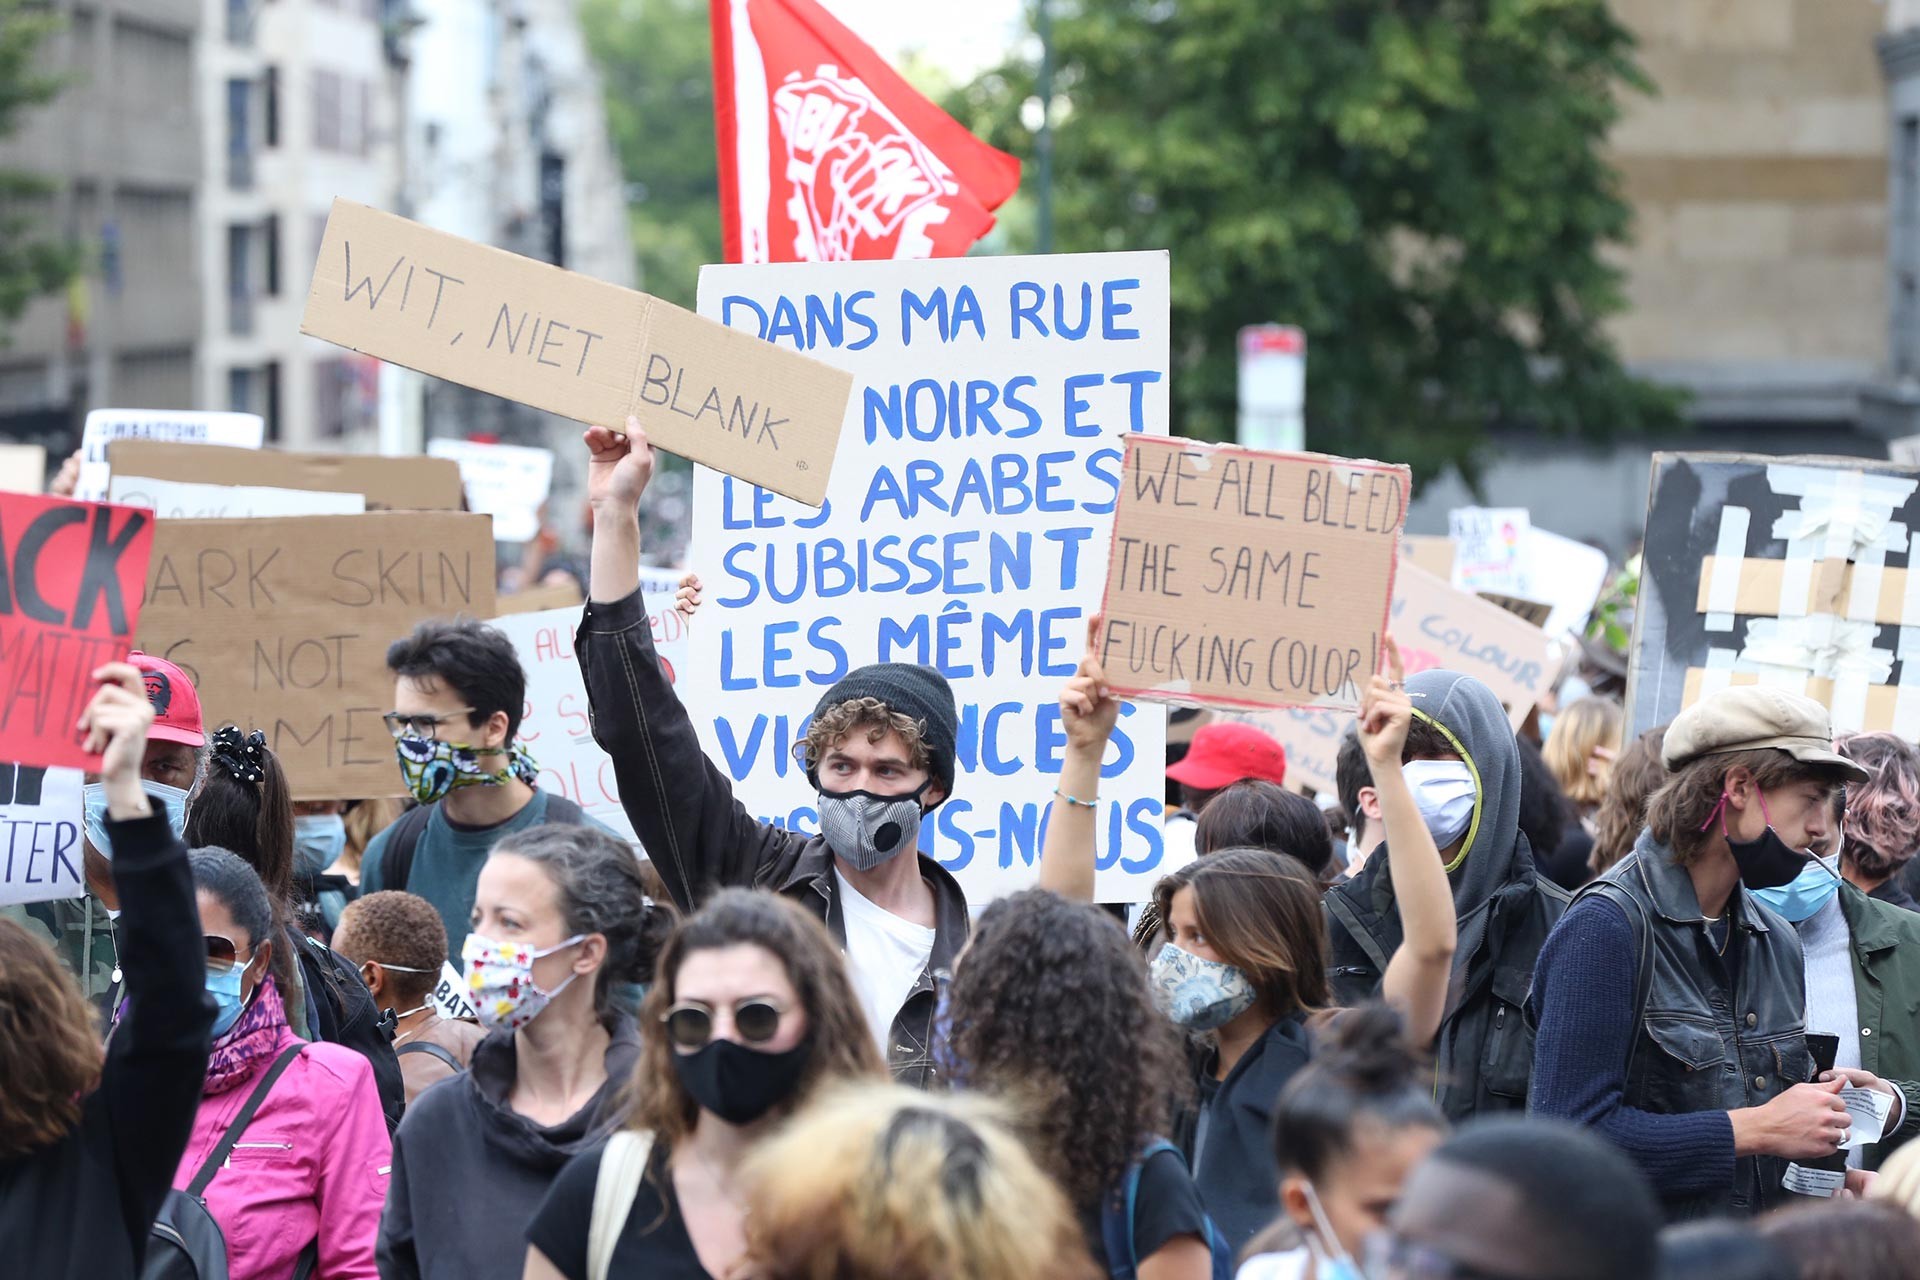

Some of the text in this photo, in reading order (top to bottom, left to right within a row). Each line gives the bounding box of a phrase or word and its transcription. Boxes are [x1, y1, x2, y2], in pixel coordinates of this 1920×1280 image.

[344, 241, 790, 451] WIT, NIET BLANK
[722, 278, 1140, 351] DANS MA RUE
[863, 370, 1162, 445] NOIRS ET
[860, 447, 1123, 522] ARABES
[1134, 447, 1203, 507] WE
[1213, 458, 1286, 521] ALL
[1302, 469, 1402, 535] BLEED
[138, 548, 472, 609] ARK SKIN
[717, 527, 1093, 608] SUBISSENT
[1117, 536, 1321, 608] THE SAME
[252, 634, 360, 692] NOT
[721, 616, 849, 692] LES
[878, 600, 1083, 679] MÊME
[0, 814, 81, 884] TER
